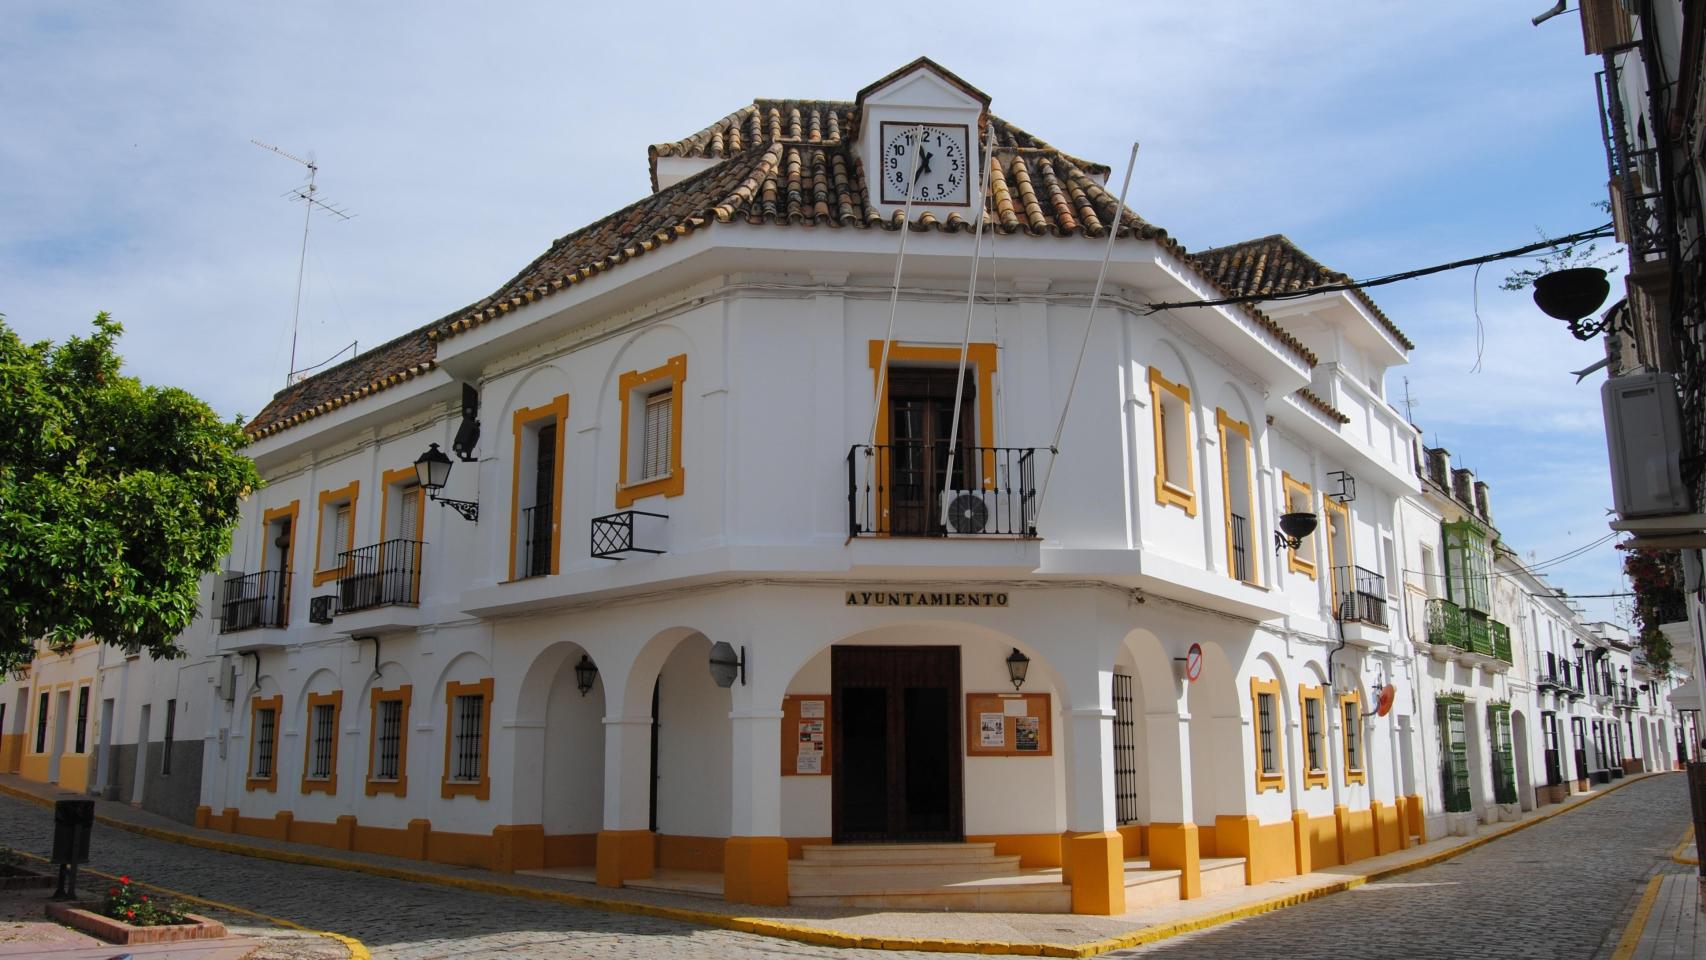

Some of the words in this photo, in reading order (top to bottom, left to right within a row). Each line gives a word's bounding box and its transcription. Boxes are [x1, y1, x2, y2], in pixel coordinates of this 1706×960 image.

[937, 136, 942, 147] 1
[894, 144, 904, 156] 10
[946, 146, 954, 157] 2
[890, 158, 897, 169] 9
[952, 160, 958, 170] 3
[896, 172, 903, 182] 8
[948, 174, 956, 185] 4
[922, 186, 928, 197] 6
[937, 184, 944, 195] 5
[847, 592, 1008, 606] AYUNTAMIENTO
